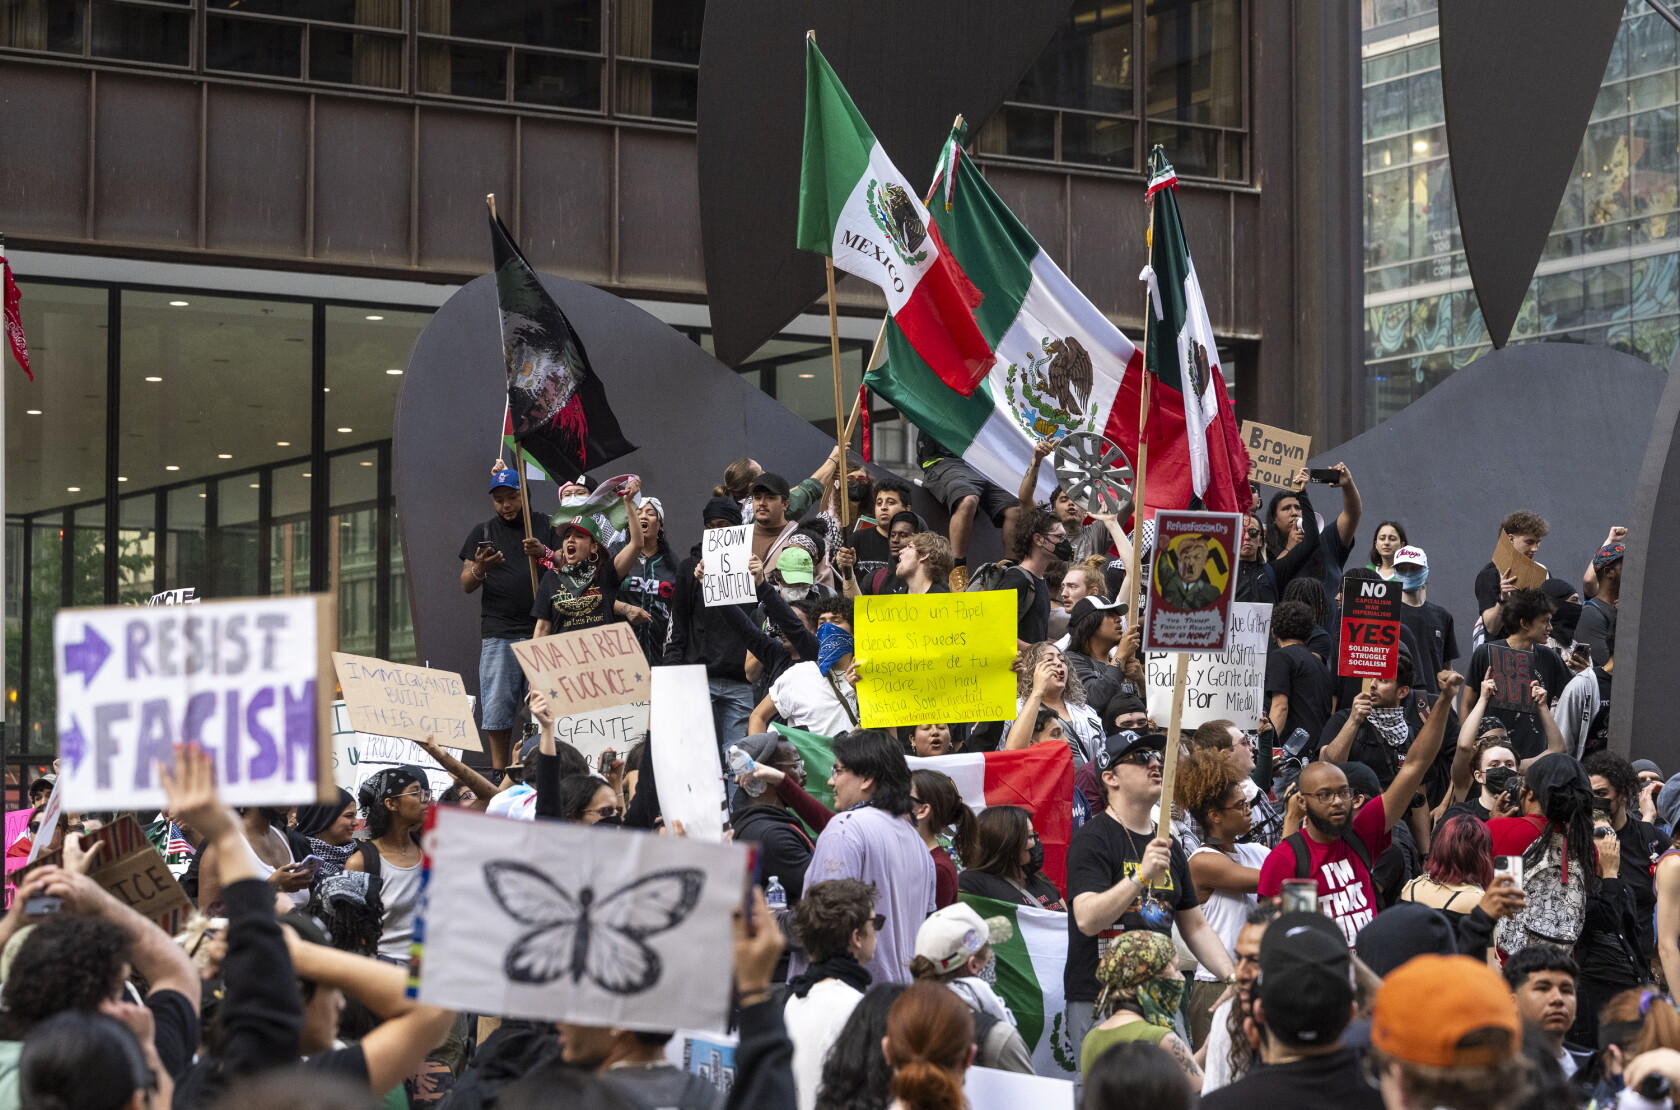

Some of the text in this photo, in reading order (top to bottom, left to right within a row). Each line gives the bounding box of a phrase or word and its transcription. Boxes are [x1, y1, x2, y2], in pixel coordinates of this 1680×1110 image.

[840, 229, 905, 293] MEXICO
[1249, 427, 1304, 460] Brown
[1258, 454, 1283, 466] and
[708, 527, 747, 552] BROWN
[1166, 520, 1228, 535] RefuseFascism.Org
[721, 553, 731, 573] IS
[703, 572, 756, 603] BEAUTIFUL
[1360, 582, 1387, 598] NO
[866, 598, 985, 622] Cuando un Papel
[1352, 609, 1392, 617] IMPERIALISM
[1355, 598, 1392, 606] CAPITALISM
[861, 633, 900, 651] decide
[1347, 622, 1397, 646] YES
[125, 614, 288, 680] RESIST
[516, 627, 642, 672] VIVA LA RAZA
[1348, 645, 1390, 654] SOLIDARITY
[1350, 652, 1387, 661] STRUGGLE
[864, 653, 989, 676] despedirte de tu
[1348, 659, 1387, 668] SOCIALISM
[1492, 647, 1530, 678] ICE
[344, 662, 462, 696] IMMIGRANTS
[558, 668, 634, 703] FUCK ICE
[954, 674, 978, 692] hay
[1148, 663, 1192, 687] Padrs
[1208, 666, 1242, 687] Gente
[384, 686, 430, 711] BUILT
[1188, 688, 1218, 709] Por
[1491, 672, 1533, 704] OUT
[357, 705, 414, 728] THIS
[419, 715, 466, 739] CITY
[557, 715, 639, 744] GENTE
[110, 865, 171, 905] ICE
[1320, 858, 1355, 889] I'M
[1318, 881, 1368, 920] THAT
